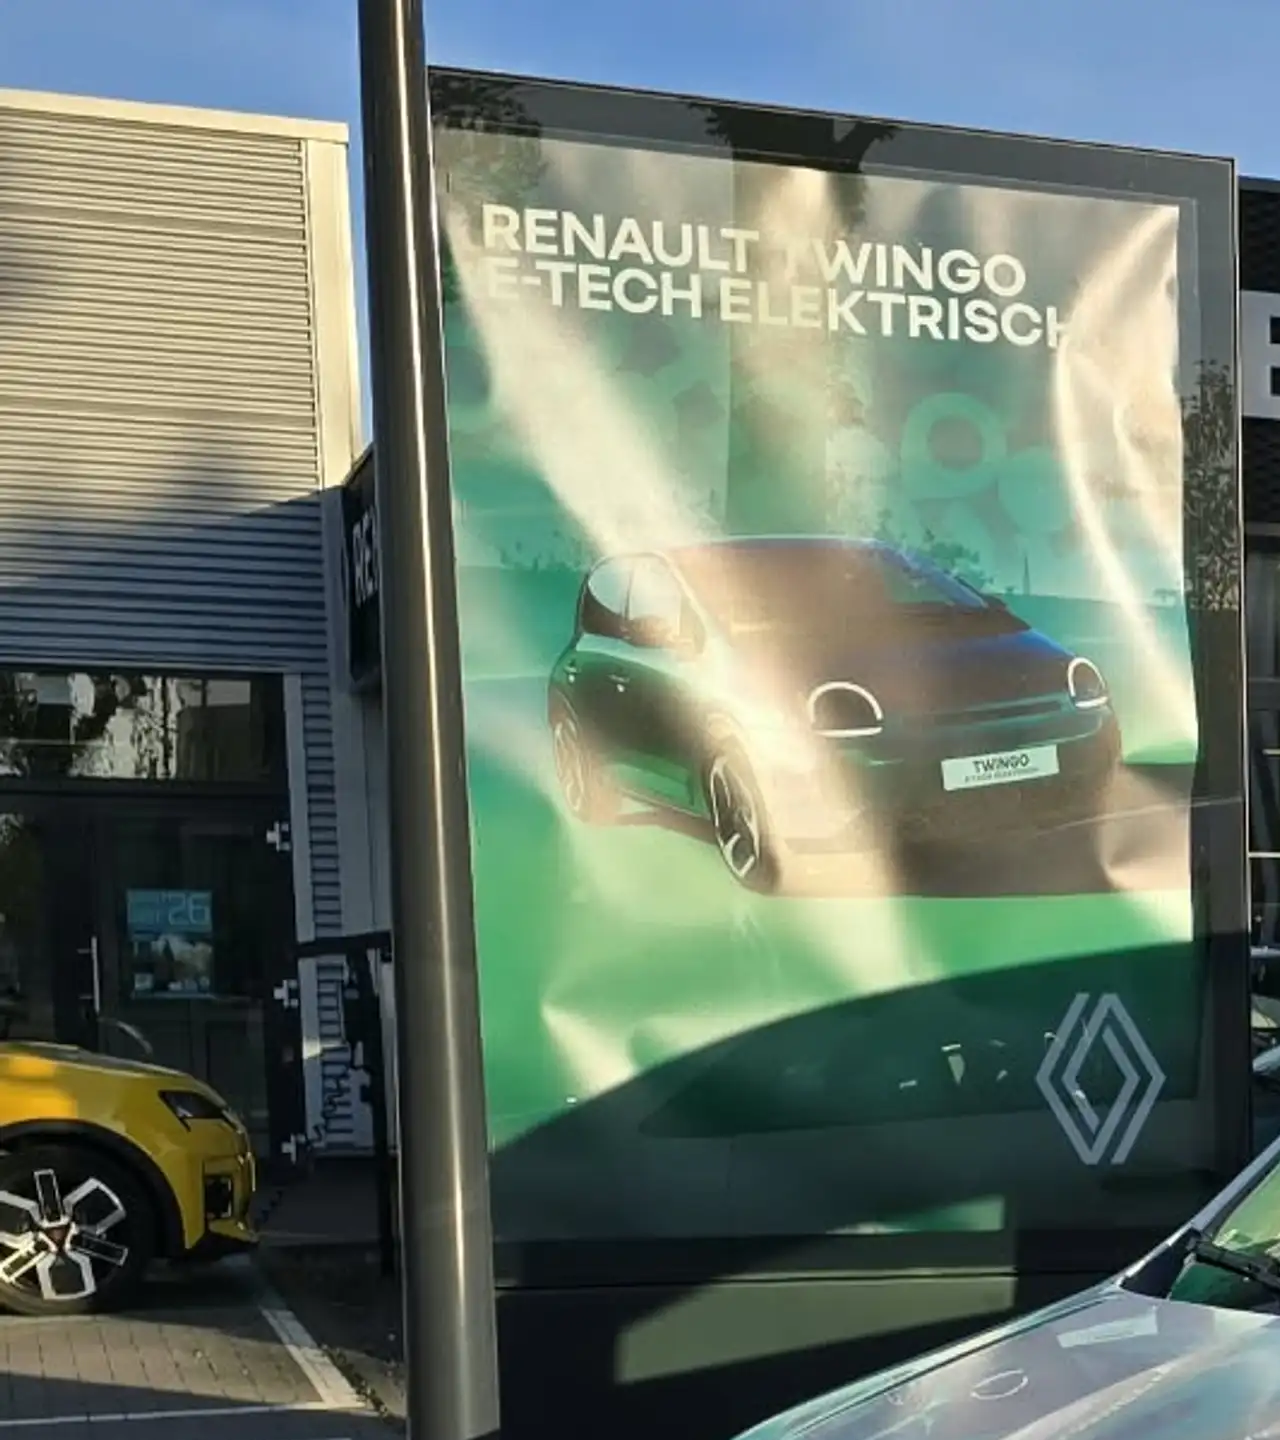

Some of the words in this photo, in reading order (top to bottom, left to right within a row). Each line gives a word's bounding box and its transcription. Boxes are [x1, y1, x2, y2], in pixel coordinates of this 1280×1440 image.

[482, 203, 760, 273] RENAULT
[769, 235, 1026, 297] TWINGO
[483, 256, 703, 319] E-TECH
[972, 754, 1030, 774] TWINGO
